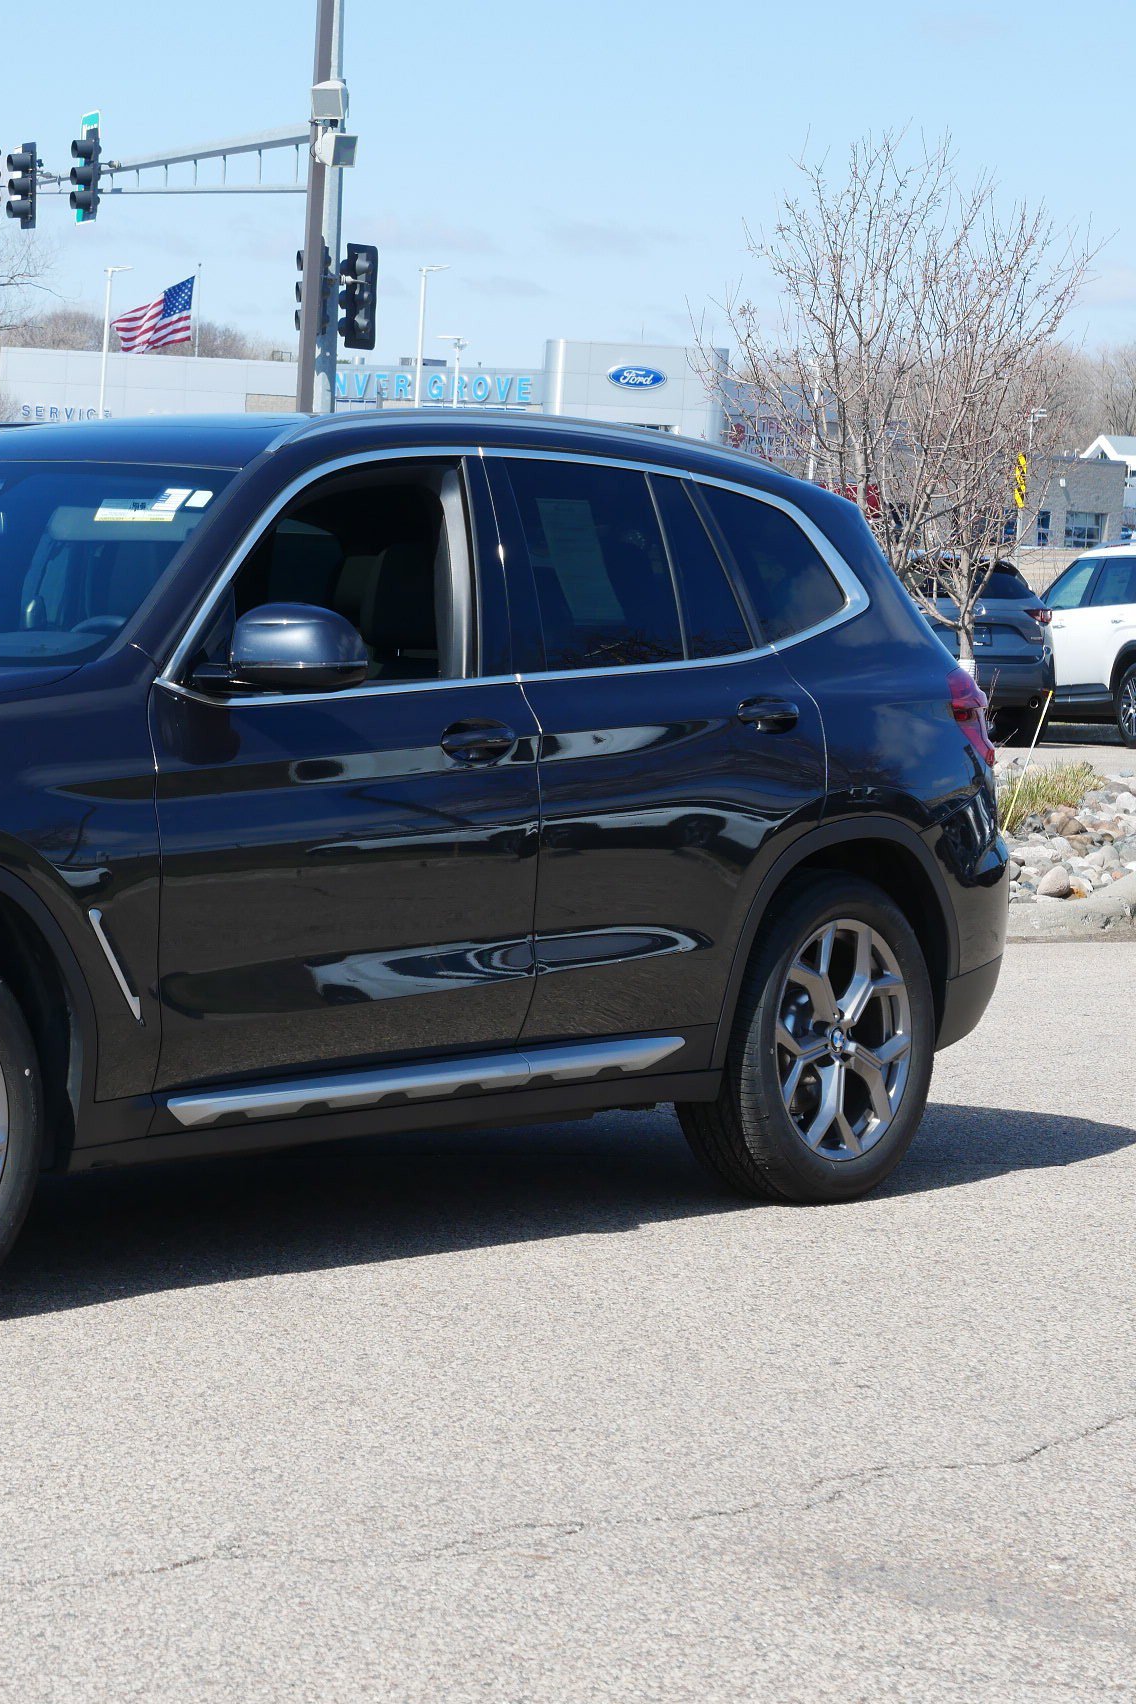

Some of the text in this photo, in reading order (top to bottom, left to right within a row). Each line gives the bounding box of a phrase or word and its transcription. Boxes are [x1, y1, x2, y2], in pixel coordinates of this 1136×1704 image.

[335, 372, 531, 402] NVER GROVE
[619, 369, 654, 385] Ford
